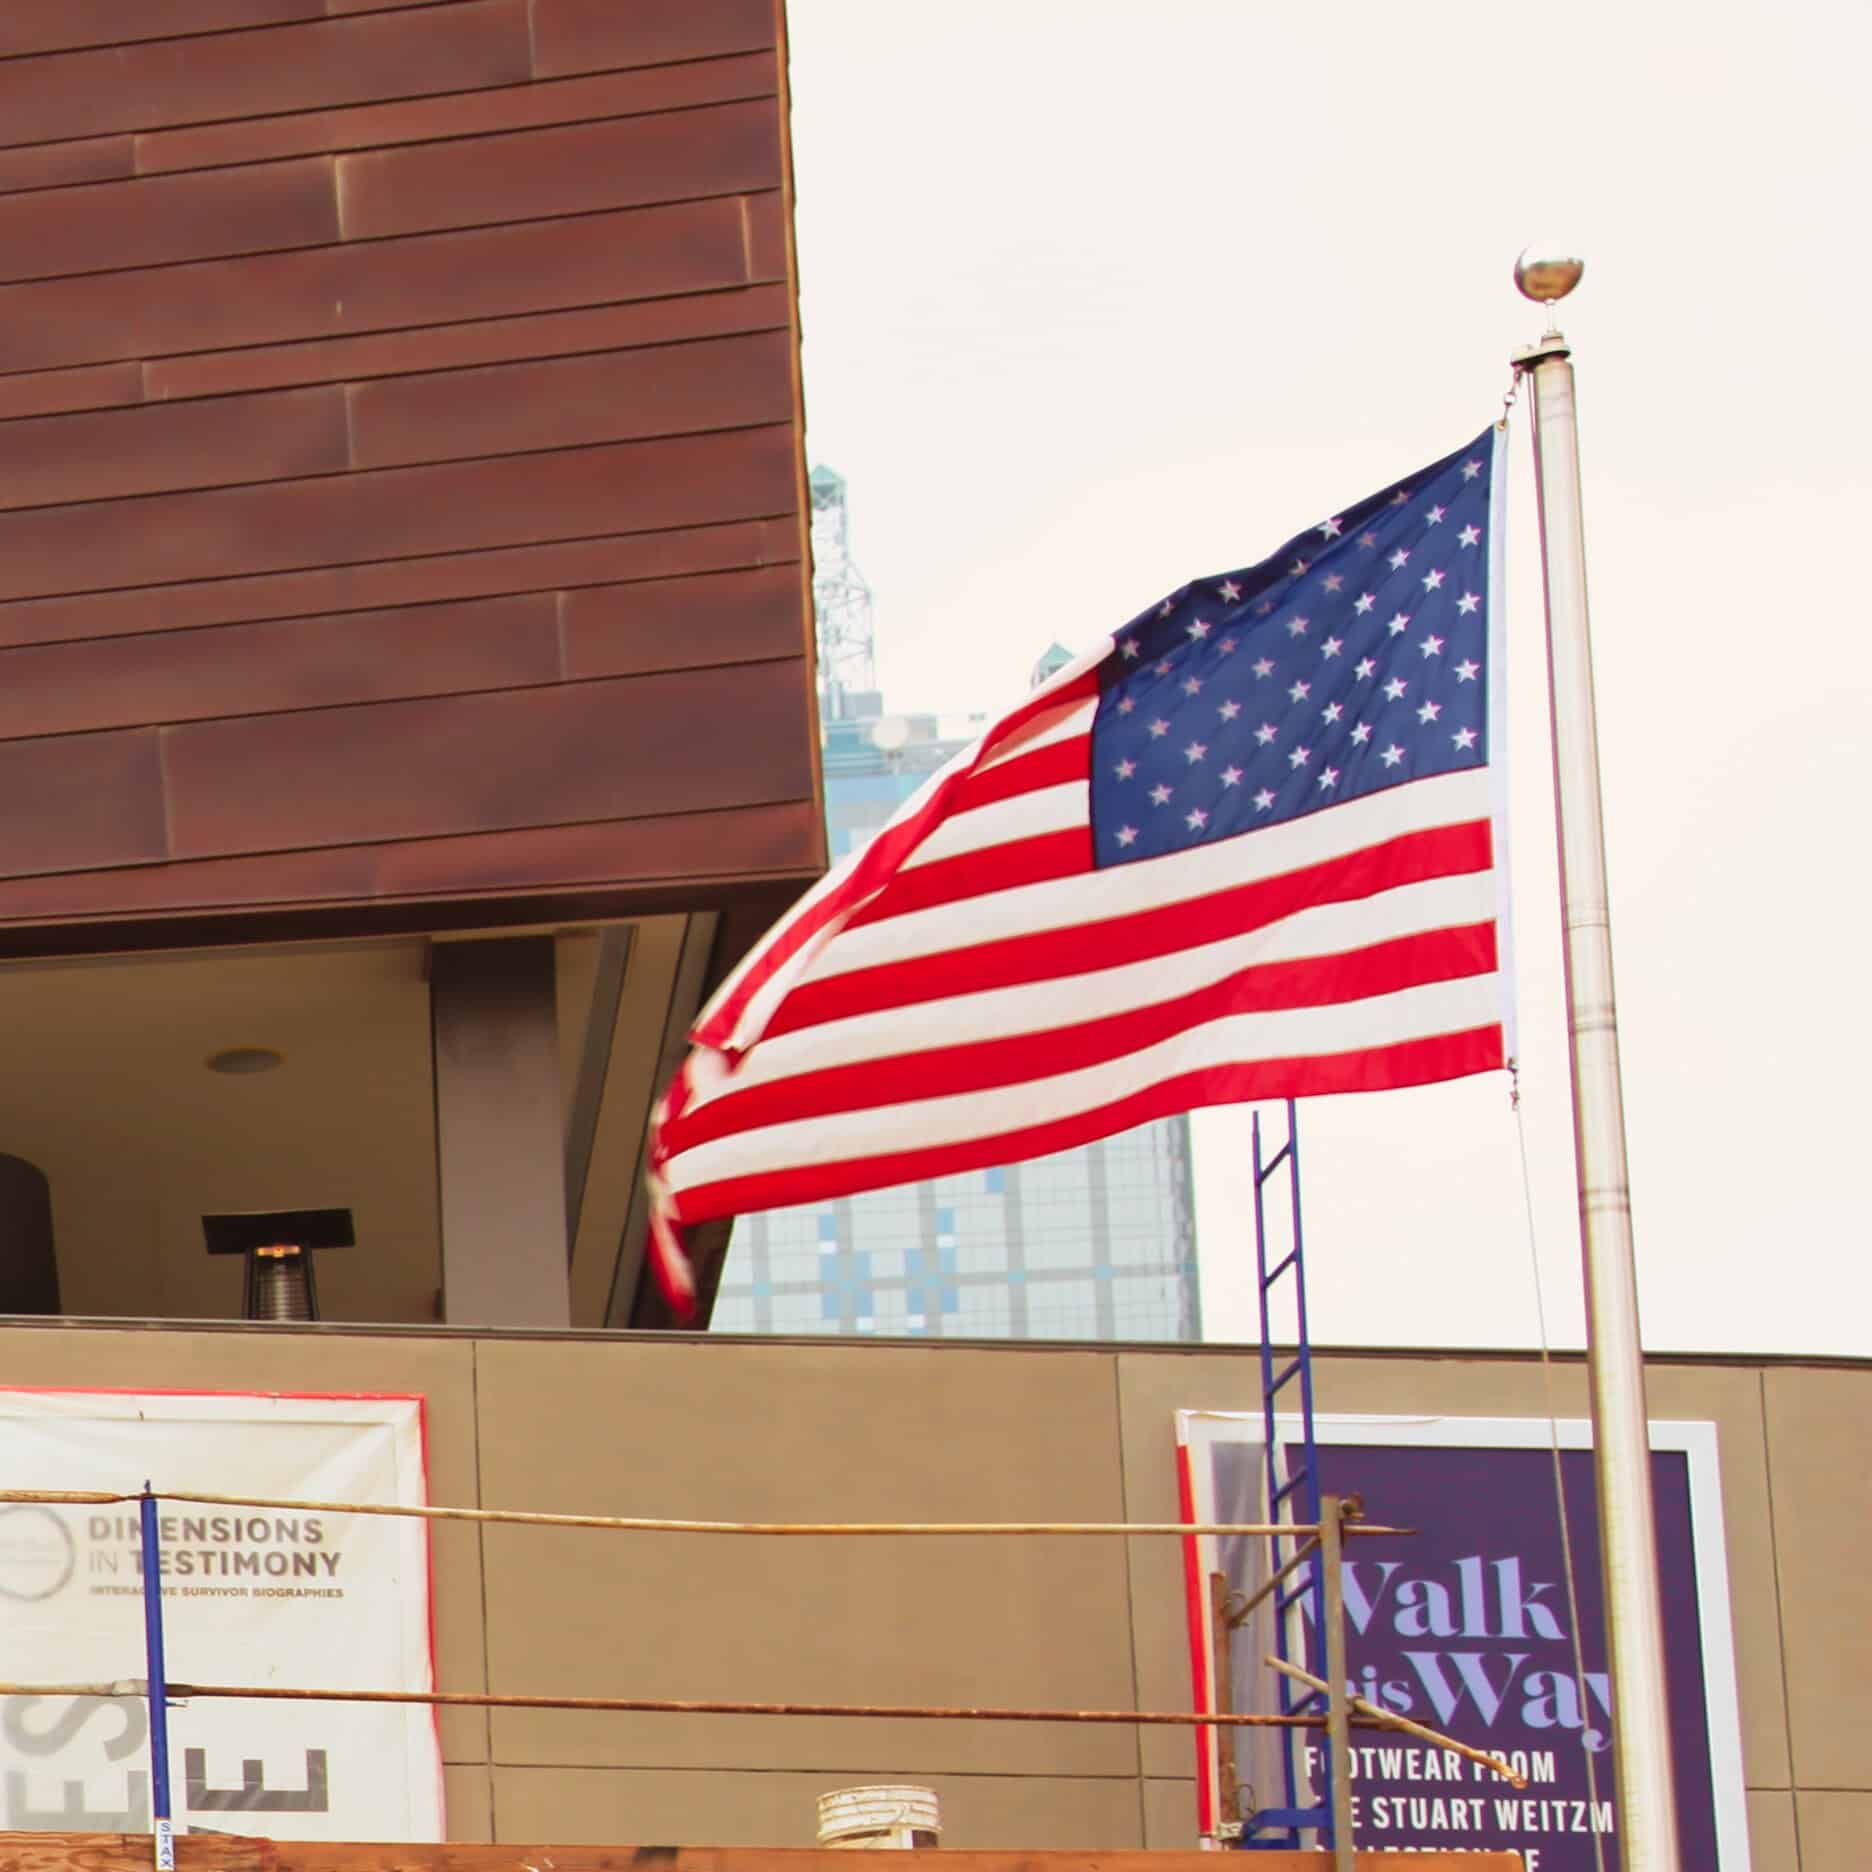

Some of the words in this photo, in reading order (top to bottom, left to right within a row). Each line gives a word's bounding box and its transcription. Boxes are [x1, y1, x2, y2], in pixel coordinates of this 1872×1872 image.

[89, 1551, 118, 1574] IN
[182, 1587, 248, 1599] SURVIVOR
[253, 1587, 344, 1600] BIOGRAPHIES
[1306, 1747, 1463, 1782] FTWEAR
[1371, 1797, 1486, 1830] STUART
[159, 1822, 175, 1869] STAX
